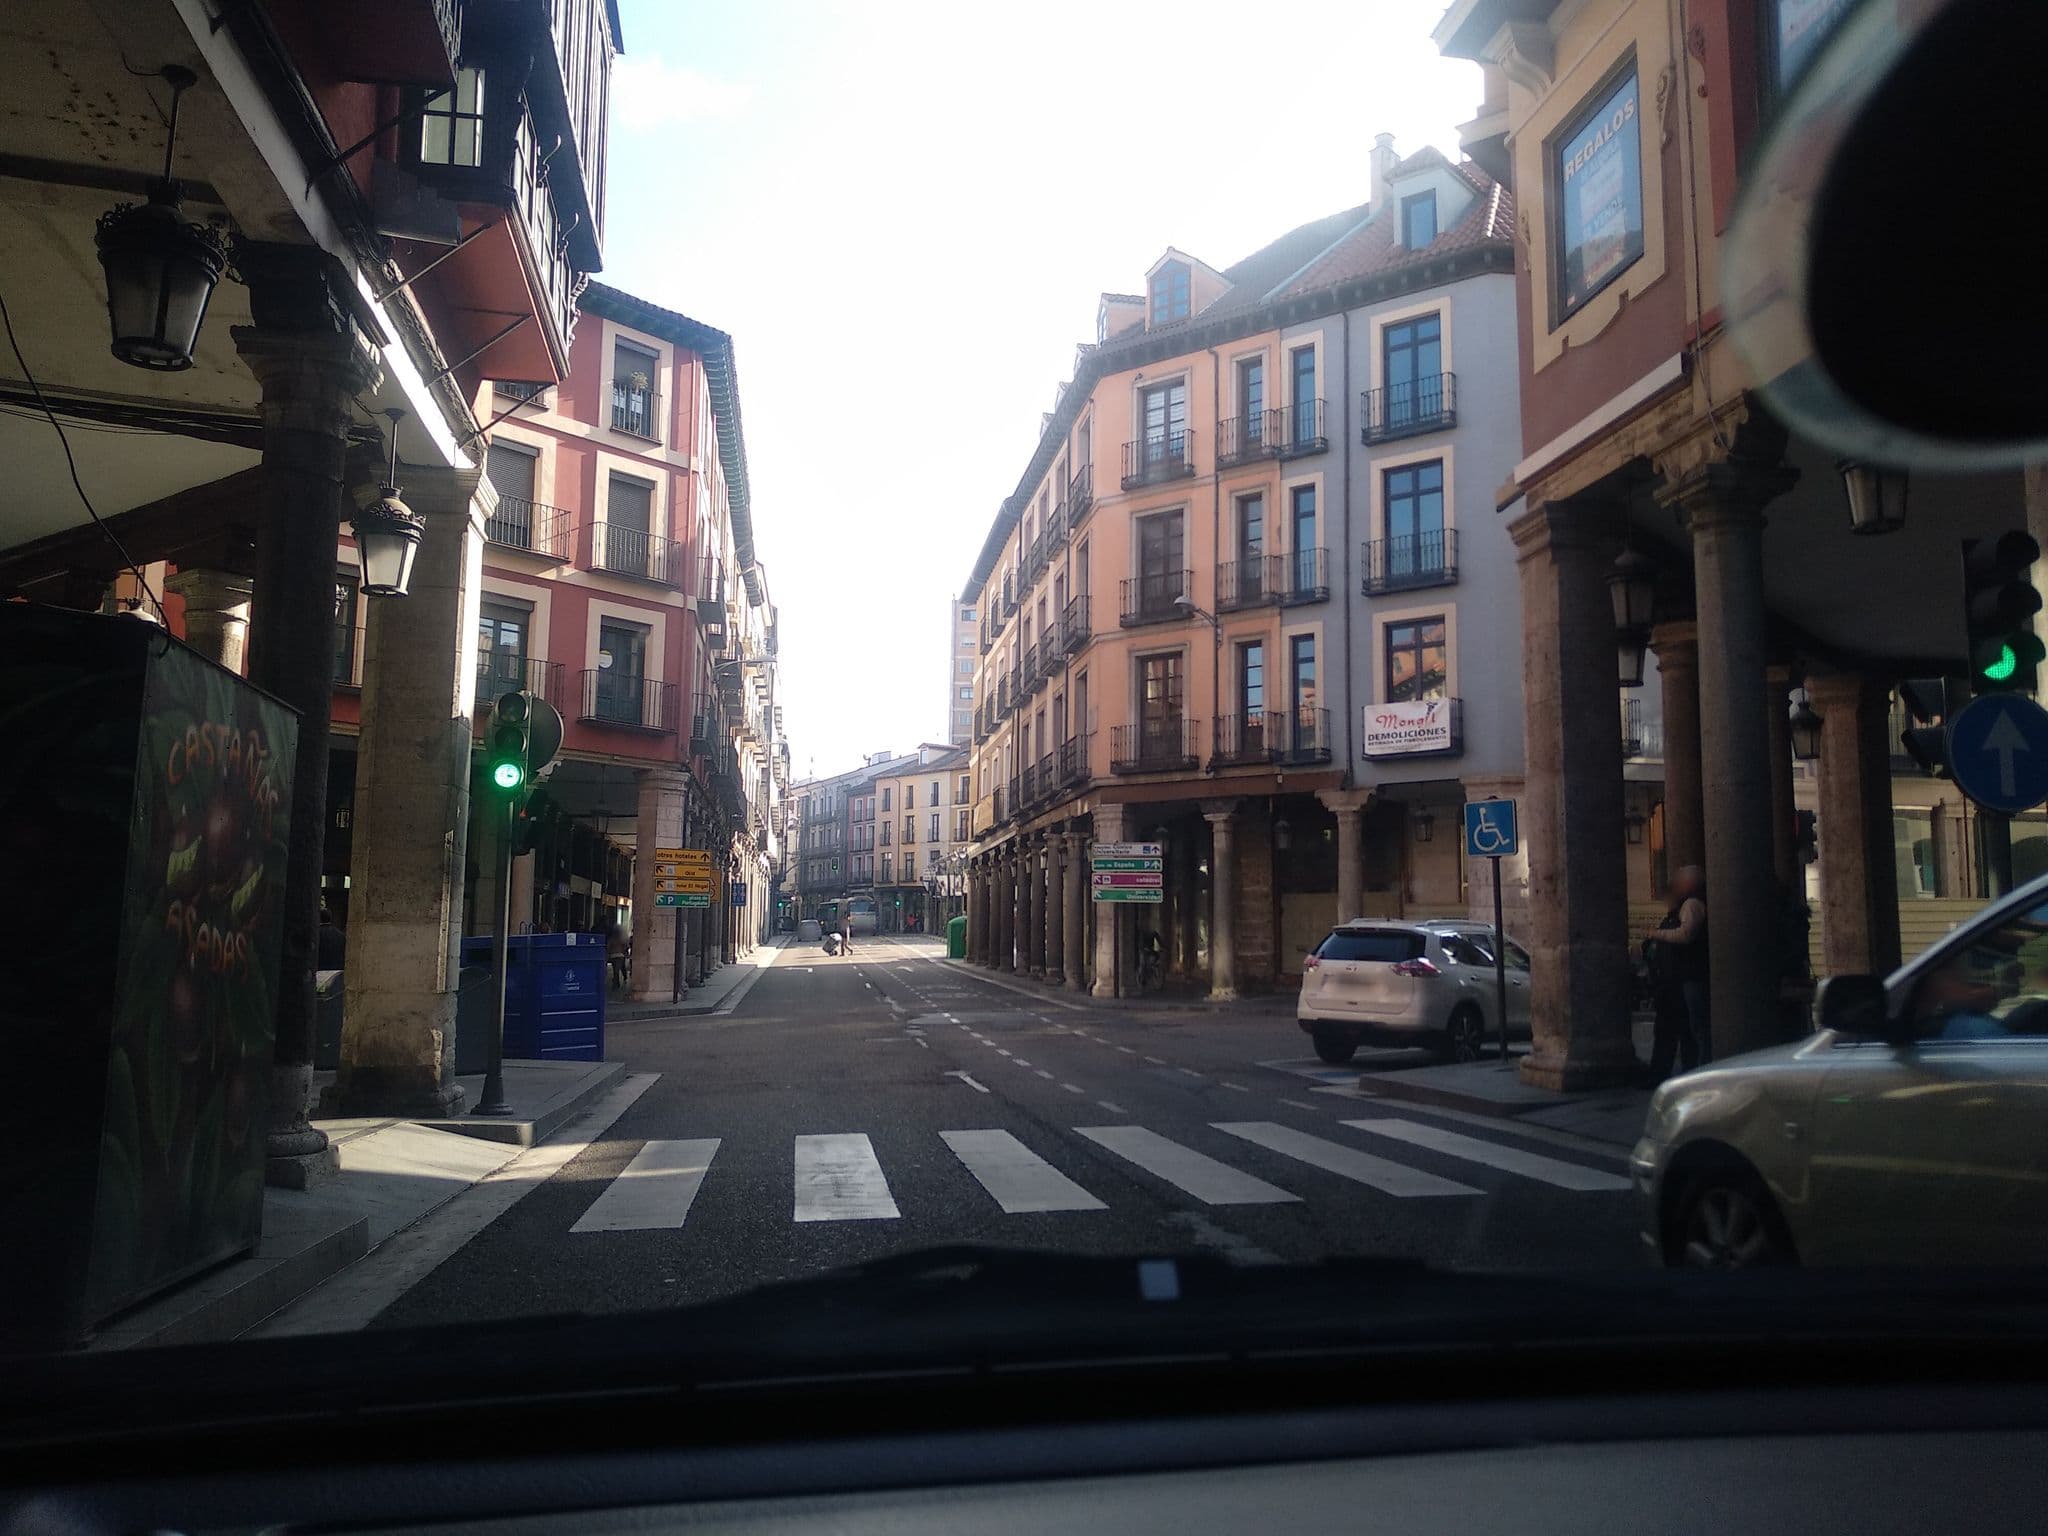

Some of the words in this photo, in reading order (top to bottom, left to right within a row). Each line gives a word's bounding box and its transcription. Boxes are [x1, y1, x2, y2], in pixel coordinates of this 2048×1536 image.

[1564, 98, 1635, 183] REGALOS
[1368, 726, 1447, 741] DEMOLICIONES
[667, 896, 674, 904] P
